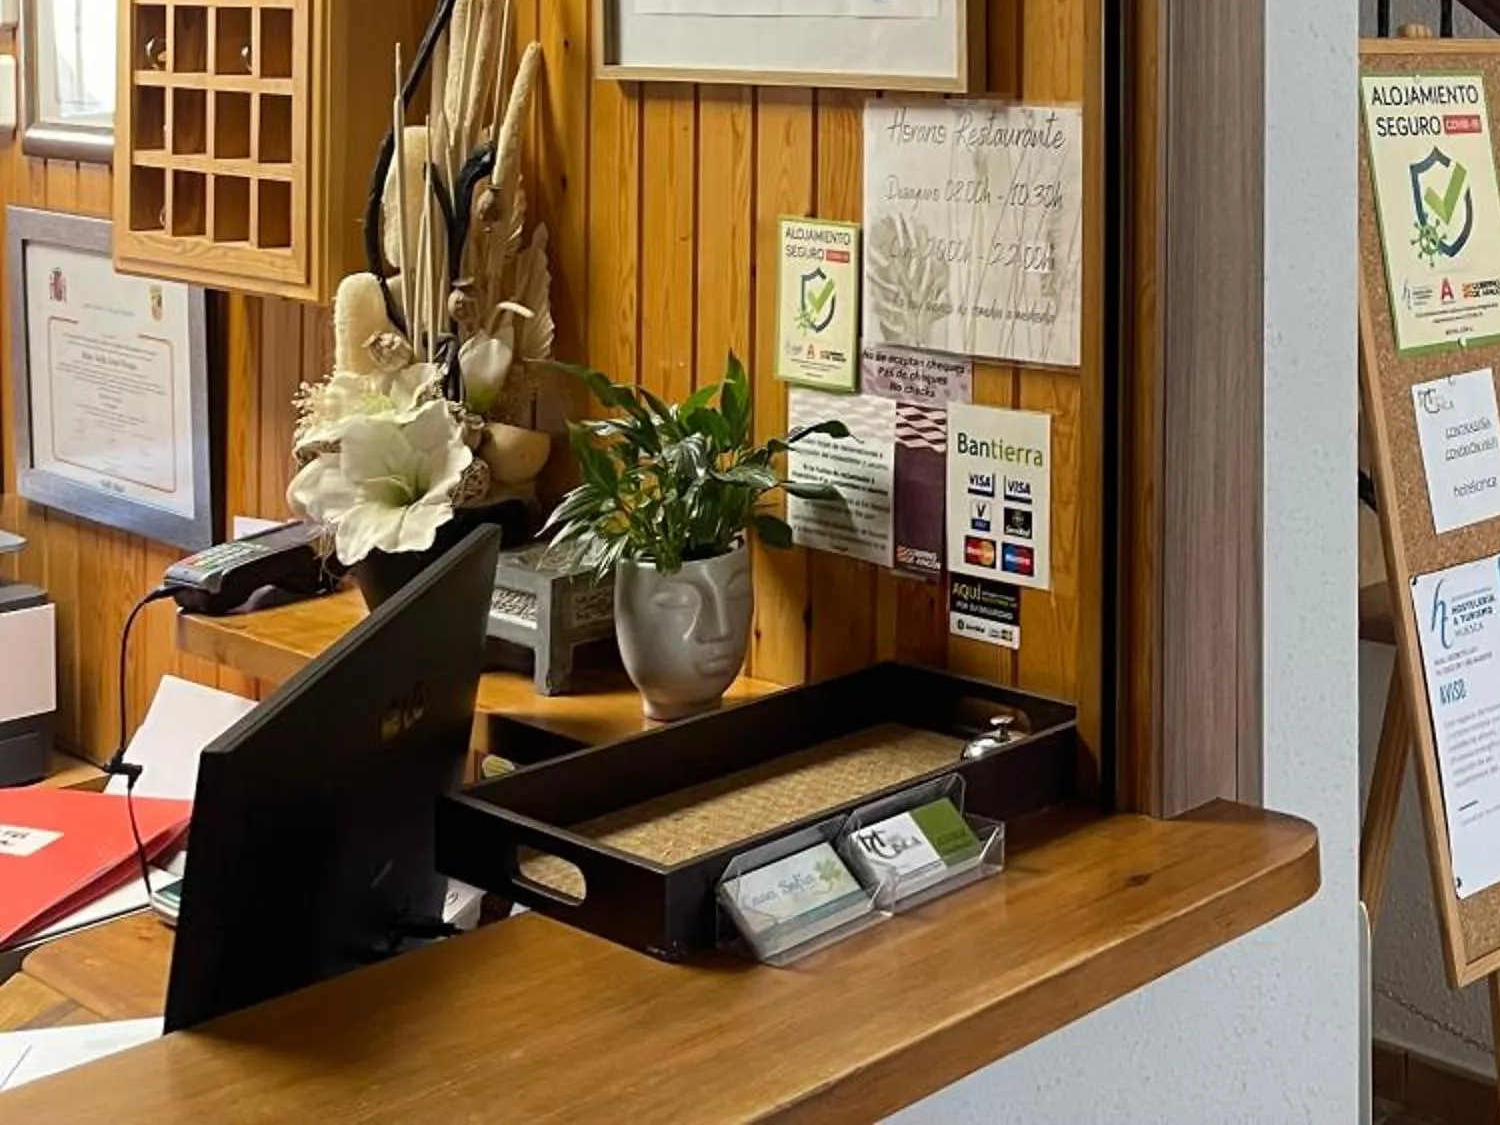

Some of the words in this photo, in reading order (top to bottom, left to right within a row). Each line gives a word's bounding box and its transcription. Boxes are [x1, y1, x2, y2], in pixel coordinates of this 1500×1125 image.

[1372, 84, 1479, 106] ALOJAMIENTO
[1376, 116, 1441, 137] SEGURO
[956, 431, 1043, 468] Bantierra
[968, 474, 991, 488] VISA
[1007, 479, 1031, 495] VISA
